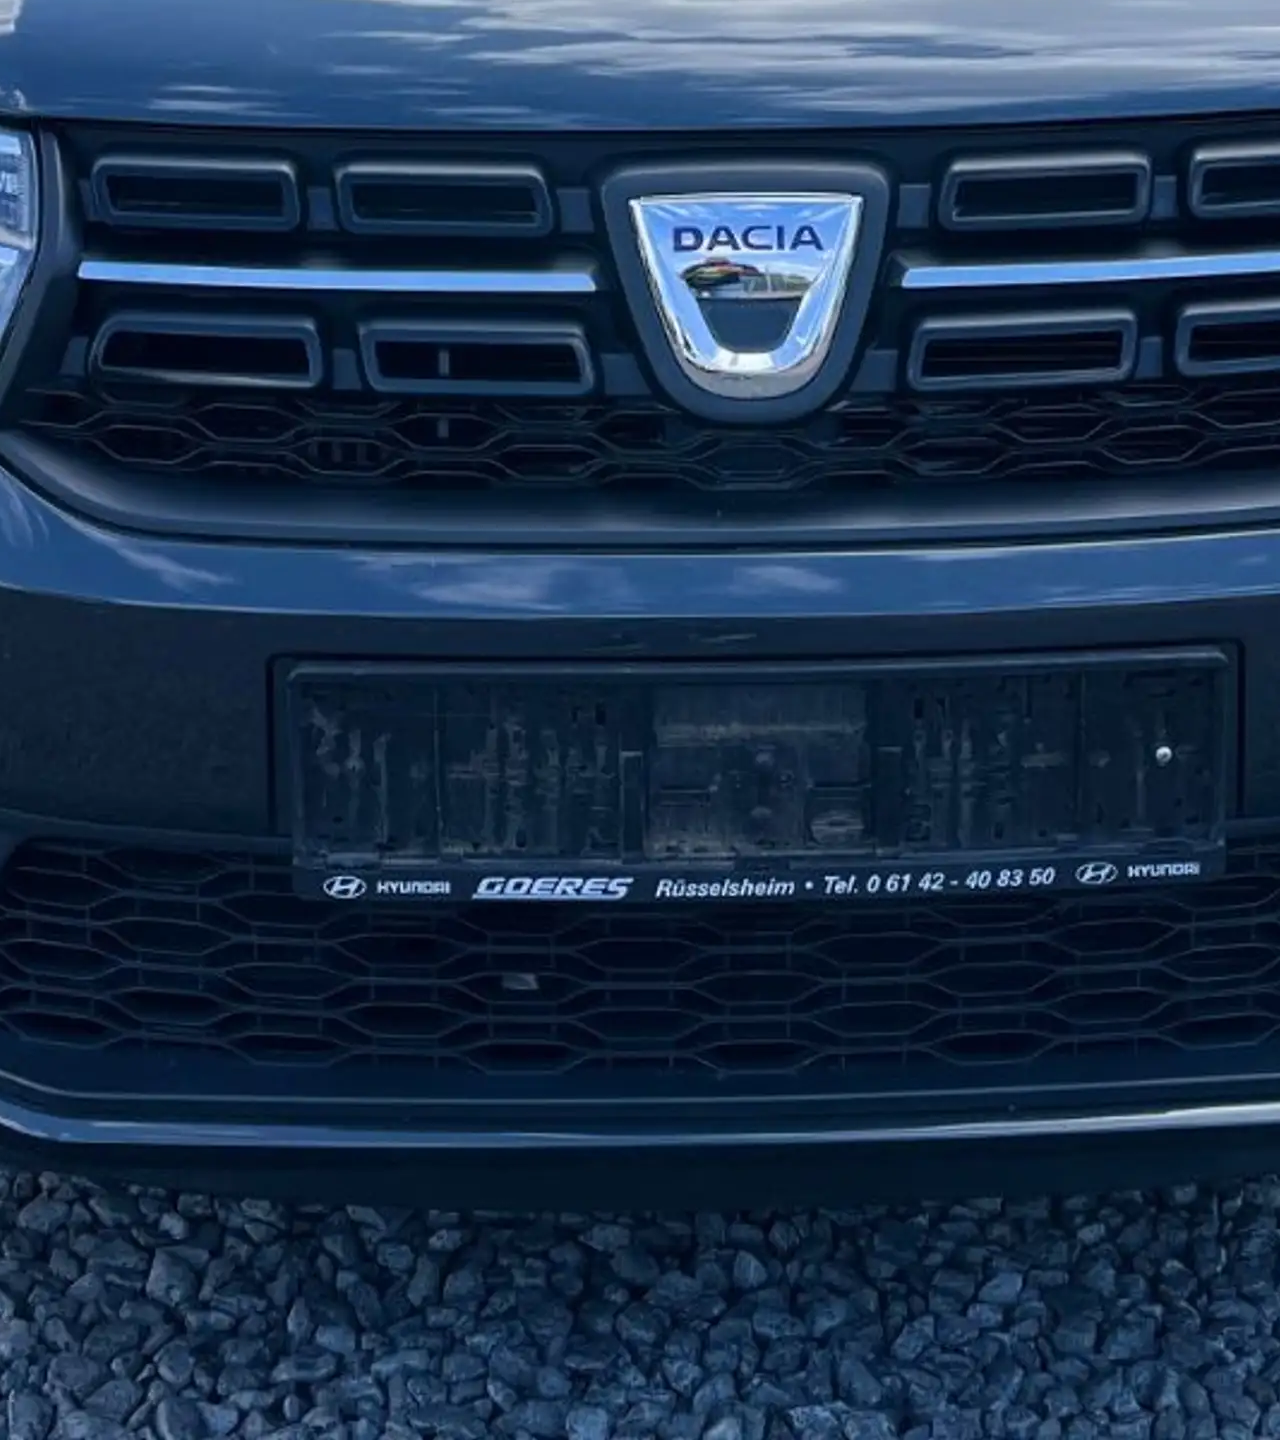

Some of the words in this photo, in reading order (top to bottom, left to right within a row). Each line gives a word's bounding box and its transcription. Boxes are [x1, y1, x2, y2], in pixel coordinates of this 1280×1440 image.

[673, 225, 824, 252] DACIA
[1127, 862, 1201, 878] HYUNDAI
[376, 879, 451, 895] HYUNDAI
[472, 876, 634, 900] GOERES
[655, 877, 796, 898] Rüsselsheim
[824, 875, 858, 894] Tel.
[866, 874, 881, 893] 0
[885, 873, 911, 893] 61
[919, 872, 945, 891] 42
[965, 870, 992, 889] 40
[996, 869, 1021, 887] 83
[1029, 867, 1056, 885] 50
